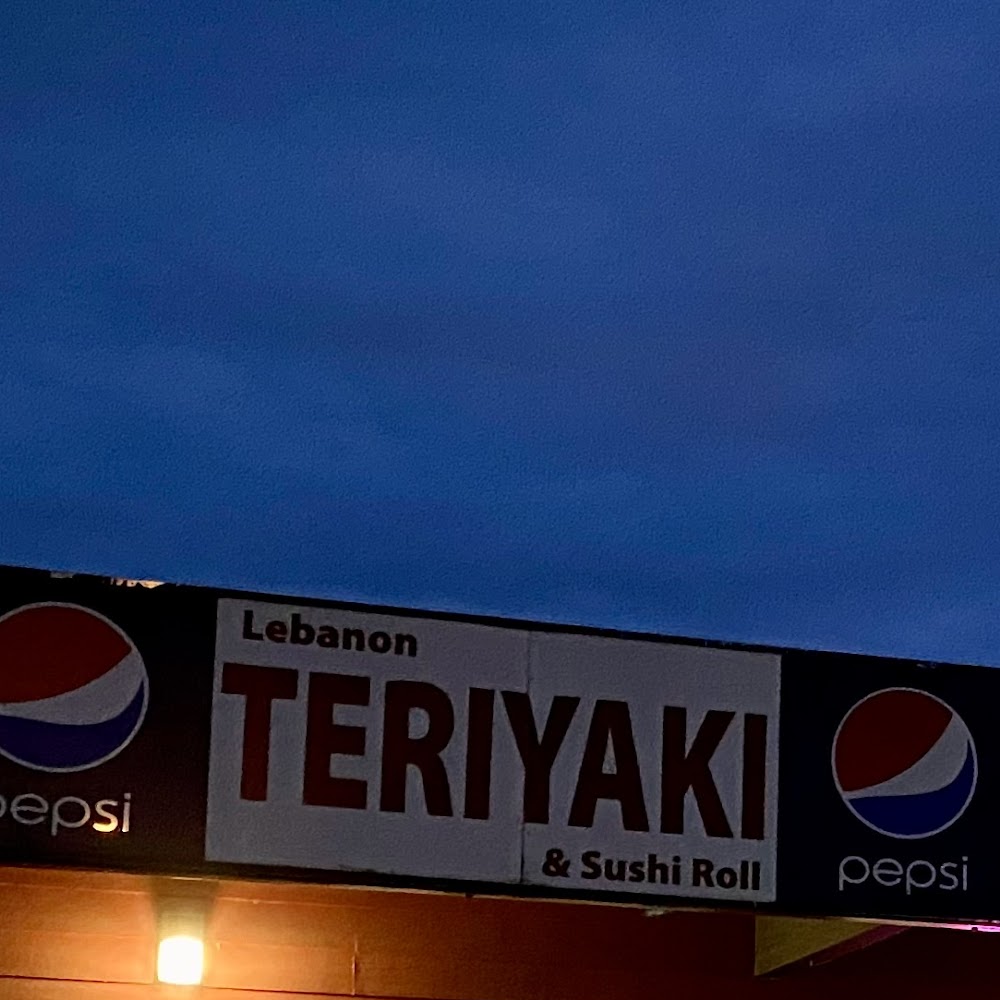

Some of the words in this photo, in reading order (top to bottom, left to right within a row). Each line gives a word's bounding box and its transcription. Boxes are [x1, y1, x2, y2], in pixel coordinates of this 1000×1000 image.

[242, 609, 418, 657] Lebanon
[221, 662, 768, 840] TERIYAKI
[0, 792, 132, 836] epsi
[542, 848, 570, 877] &
[581, 850, 681, 886] Sushi
[692, 858, 761, 891] Roll
[838, 855, 969, 895] pepsi
